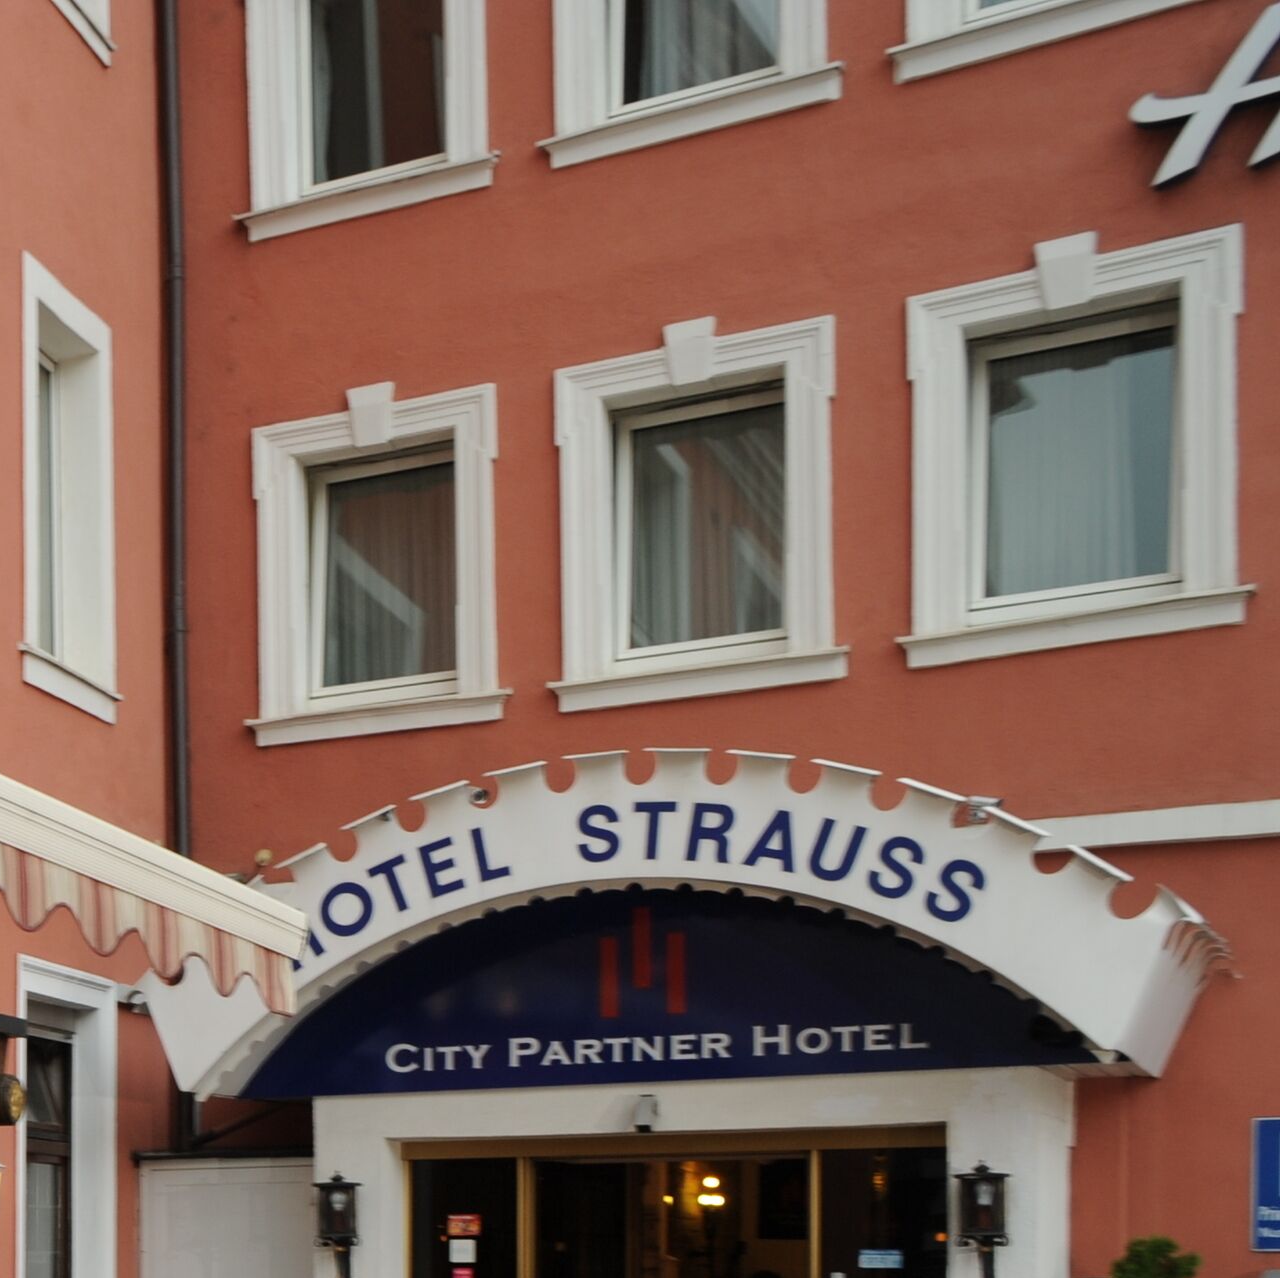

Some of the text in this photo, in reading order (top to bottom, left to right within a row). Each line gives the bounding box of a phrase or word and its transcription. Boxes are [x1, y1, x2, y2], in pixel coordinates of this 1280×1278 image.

[577, 801, 986, 922] STRAUSS
[384, 1023, 930, 1073] CITY PARTNER HOTEL
